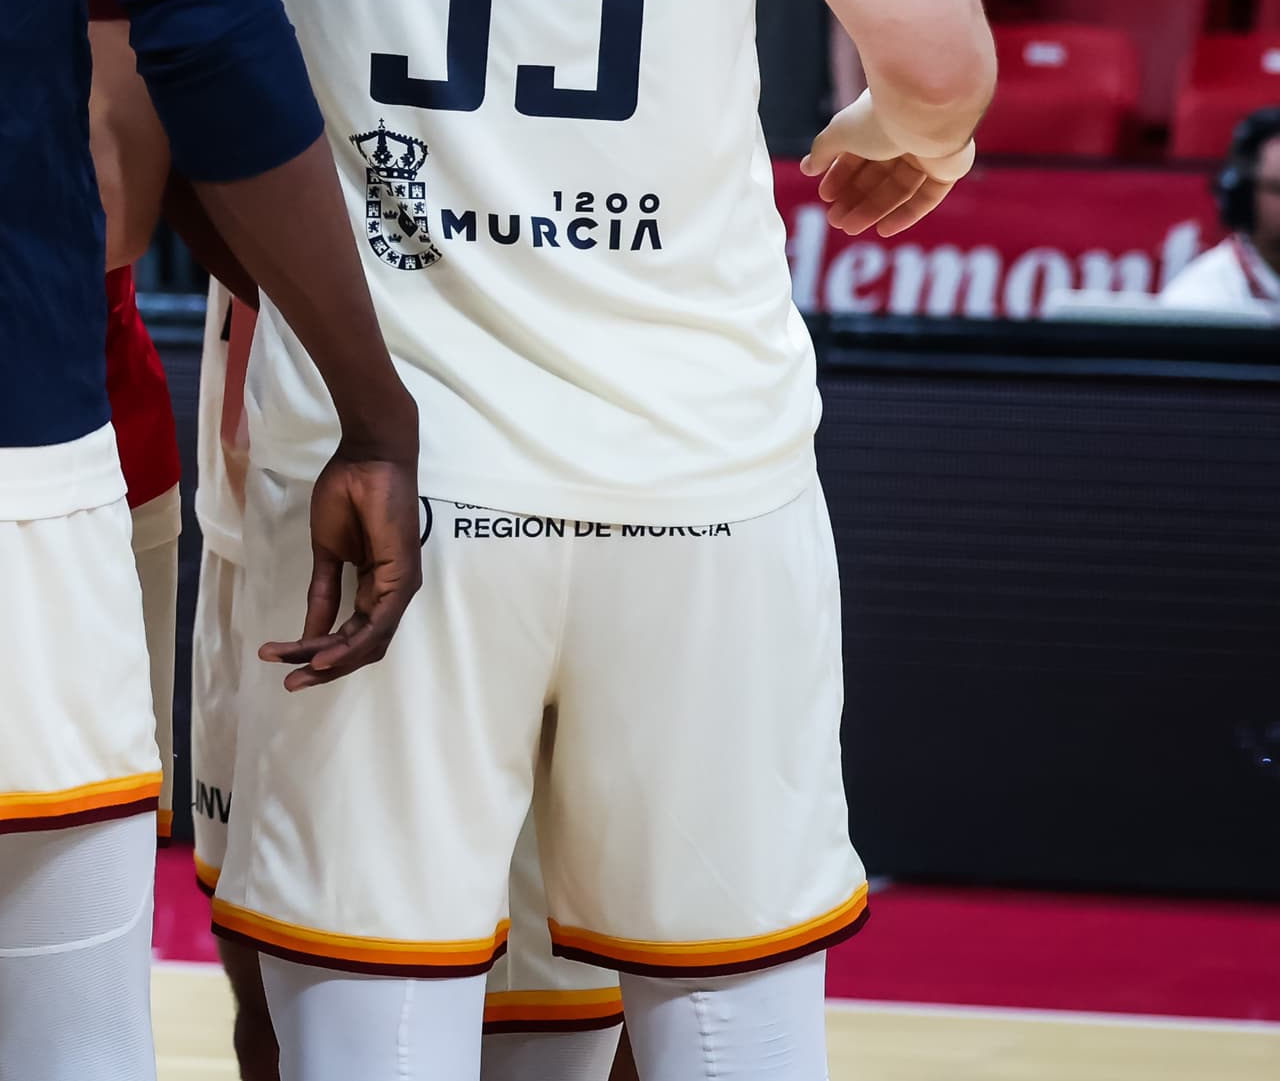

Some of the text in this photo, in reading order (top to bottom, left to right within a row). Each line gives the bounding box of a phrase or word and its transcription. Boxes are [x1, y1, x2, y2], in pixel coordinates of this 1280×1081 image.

[553, 190, 660, 214] 1200
[440, 208, 663, 251] MURCIA
[575, 520, 611, 537] DE
